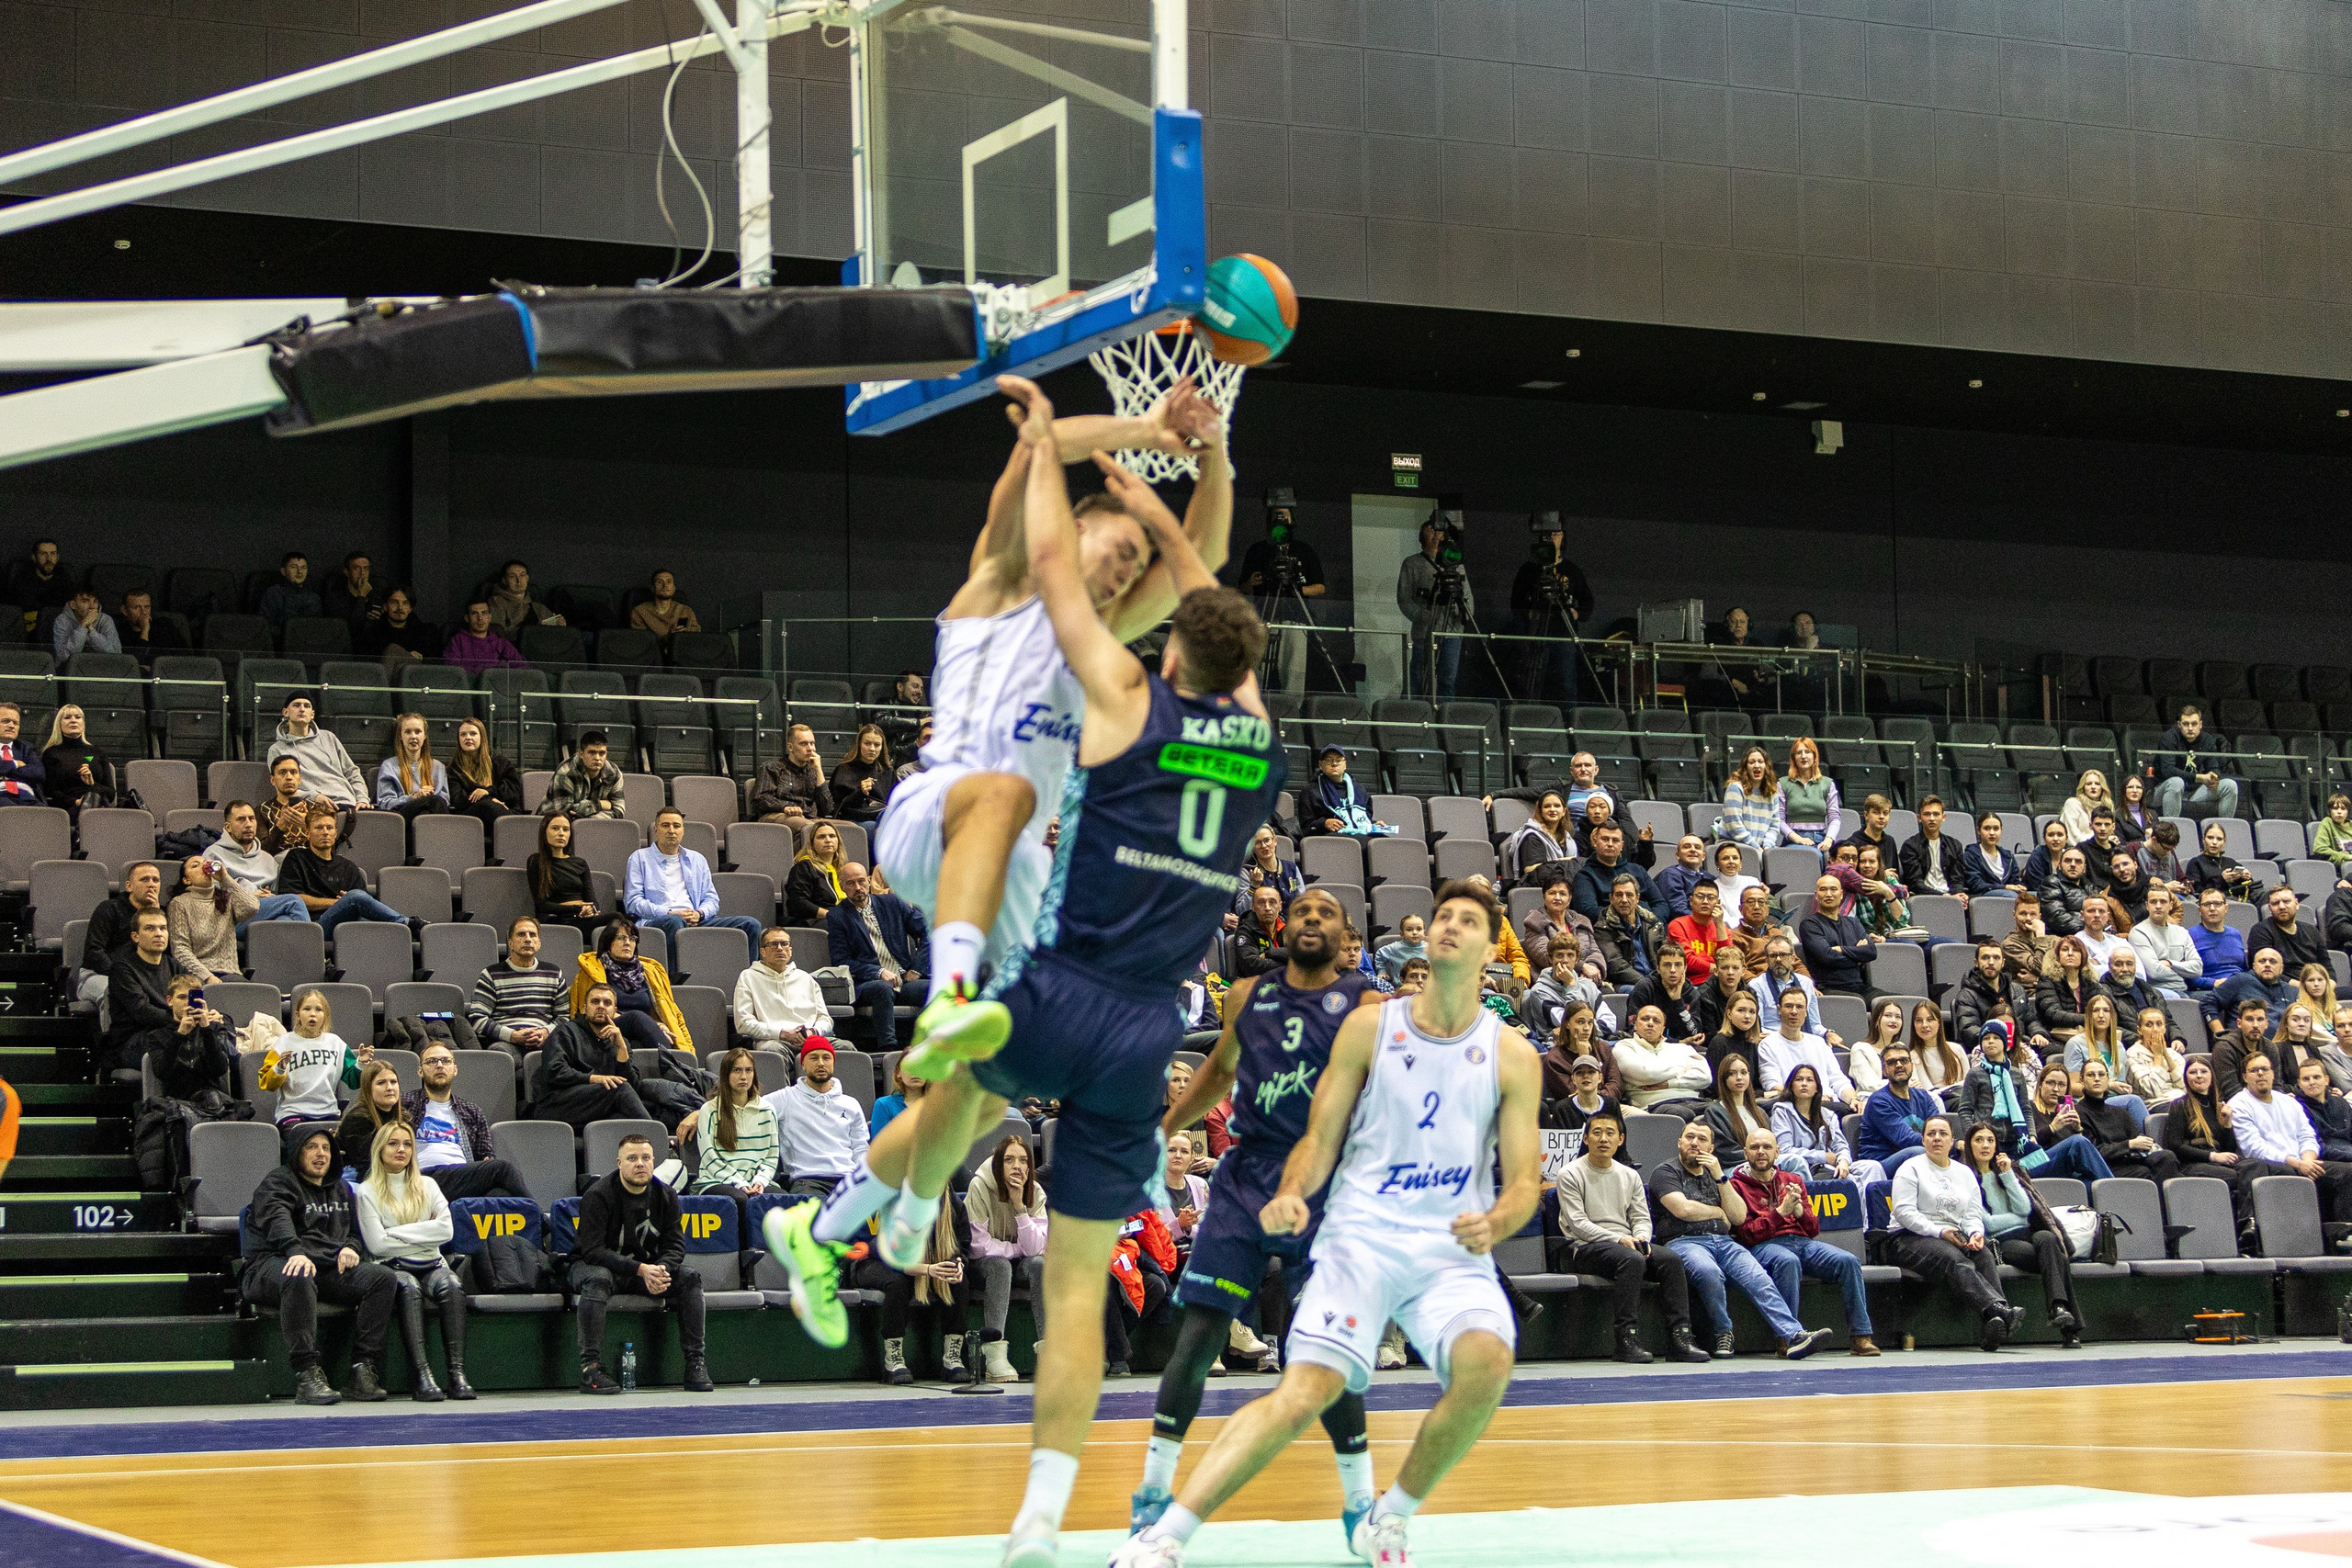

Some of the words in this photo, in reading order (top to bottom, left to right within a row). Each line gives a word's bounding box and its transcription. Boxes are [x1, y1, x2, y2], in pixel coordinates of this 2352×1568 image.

[1393, 457, 1420, 468] ВЫХОД
[1396, 476, 1416, 484] EXIT
[1178, 779, 1227, 858] 0
[1281, 1016, 1304, 1052] 3
[288, 1049, 338, 1073] HAPPY
[1418, 1090, 1440, 1129] 2
[416, 1128, 456, 1143] NASA
[1547, 1132, 1583, 1149] ВПЕРЕ
[1376, 1161, 1472, 1196] Enisey
[74, 1205, 115, 1227] 102
[1807, 1193, 1848, 1217] VIP
[472, 1213, 526, 1239] VIP
